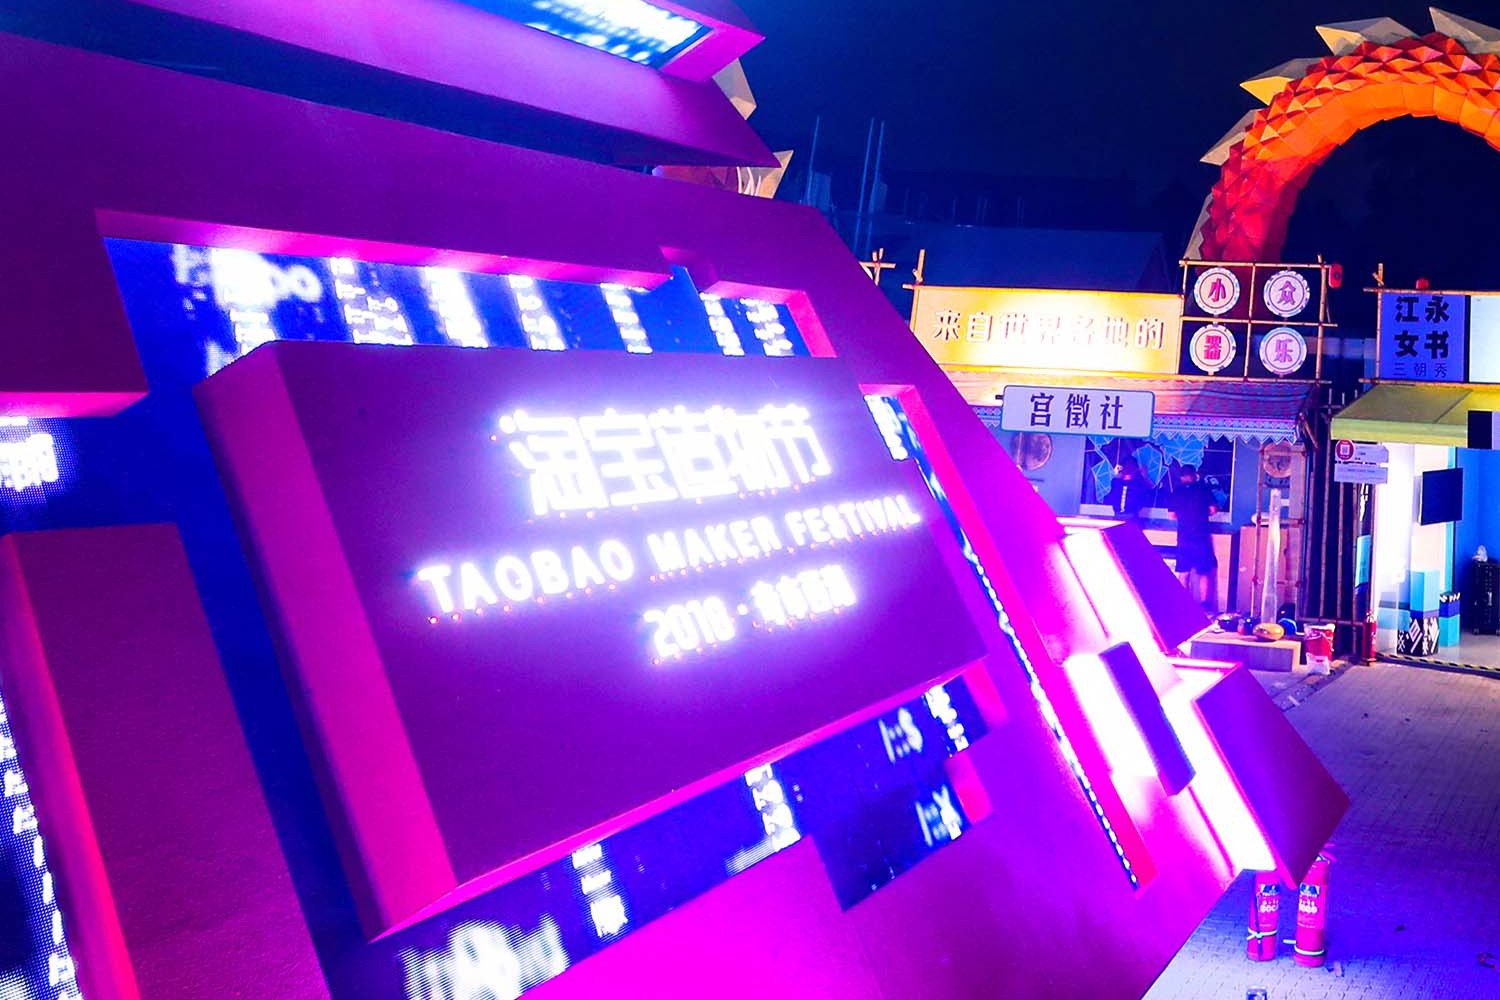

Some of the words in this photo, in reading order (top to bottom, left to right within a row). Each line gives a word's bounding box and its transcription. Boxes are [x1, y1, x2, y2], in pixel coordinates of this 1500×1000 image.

[1395, 295, 1450, 323] 江永
[1394, 330, 1449, 360] 女书
[1393, 362, 1448, 378] 三朝秀
[417, 540, 636, 614] TAOBAO
[646, 515, 783, 571] MAKER
[785, 494, 923, 547] FESTIVAL
